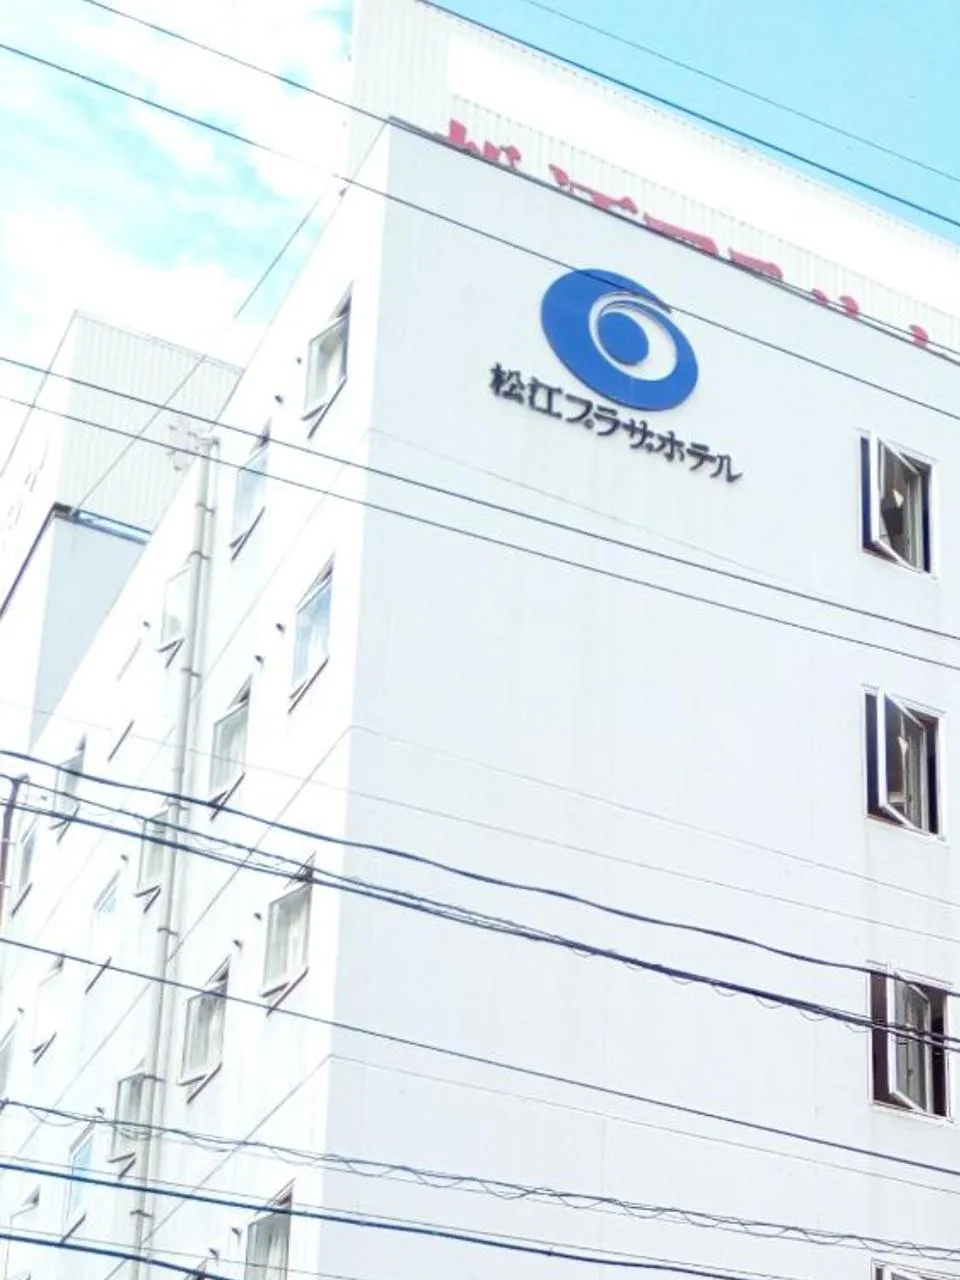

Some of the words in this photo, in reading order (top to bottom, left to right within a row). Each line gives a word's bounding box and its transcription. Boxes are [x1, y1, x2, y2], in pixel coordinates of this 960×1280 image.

[490, 363, 743, 483] 松江プラザホテル
